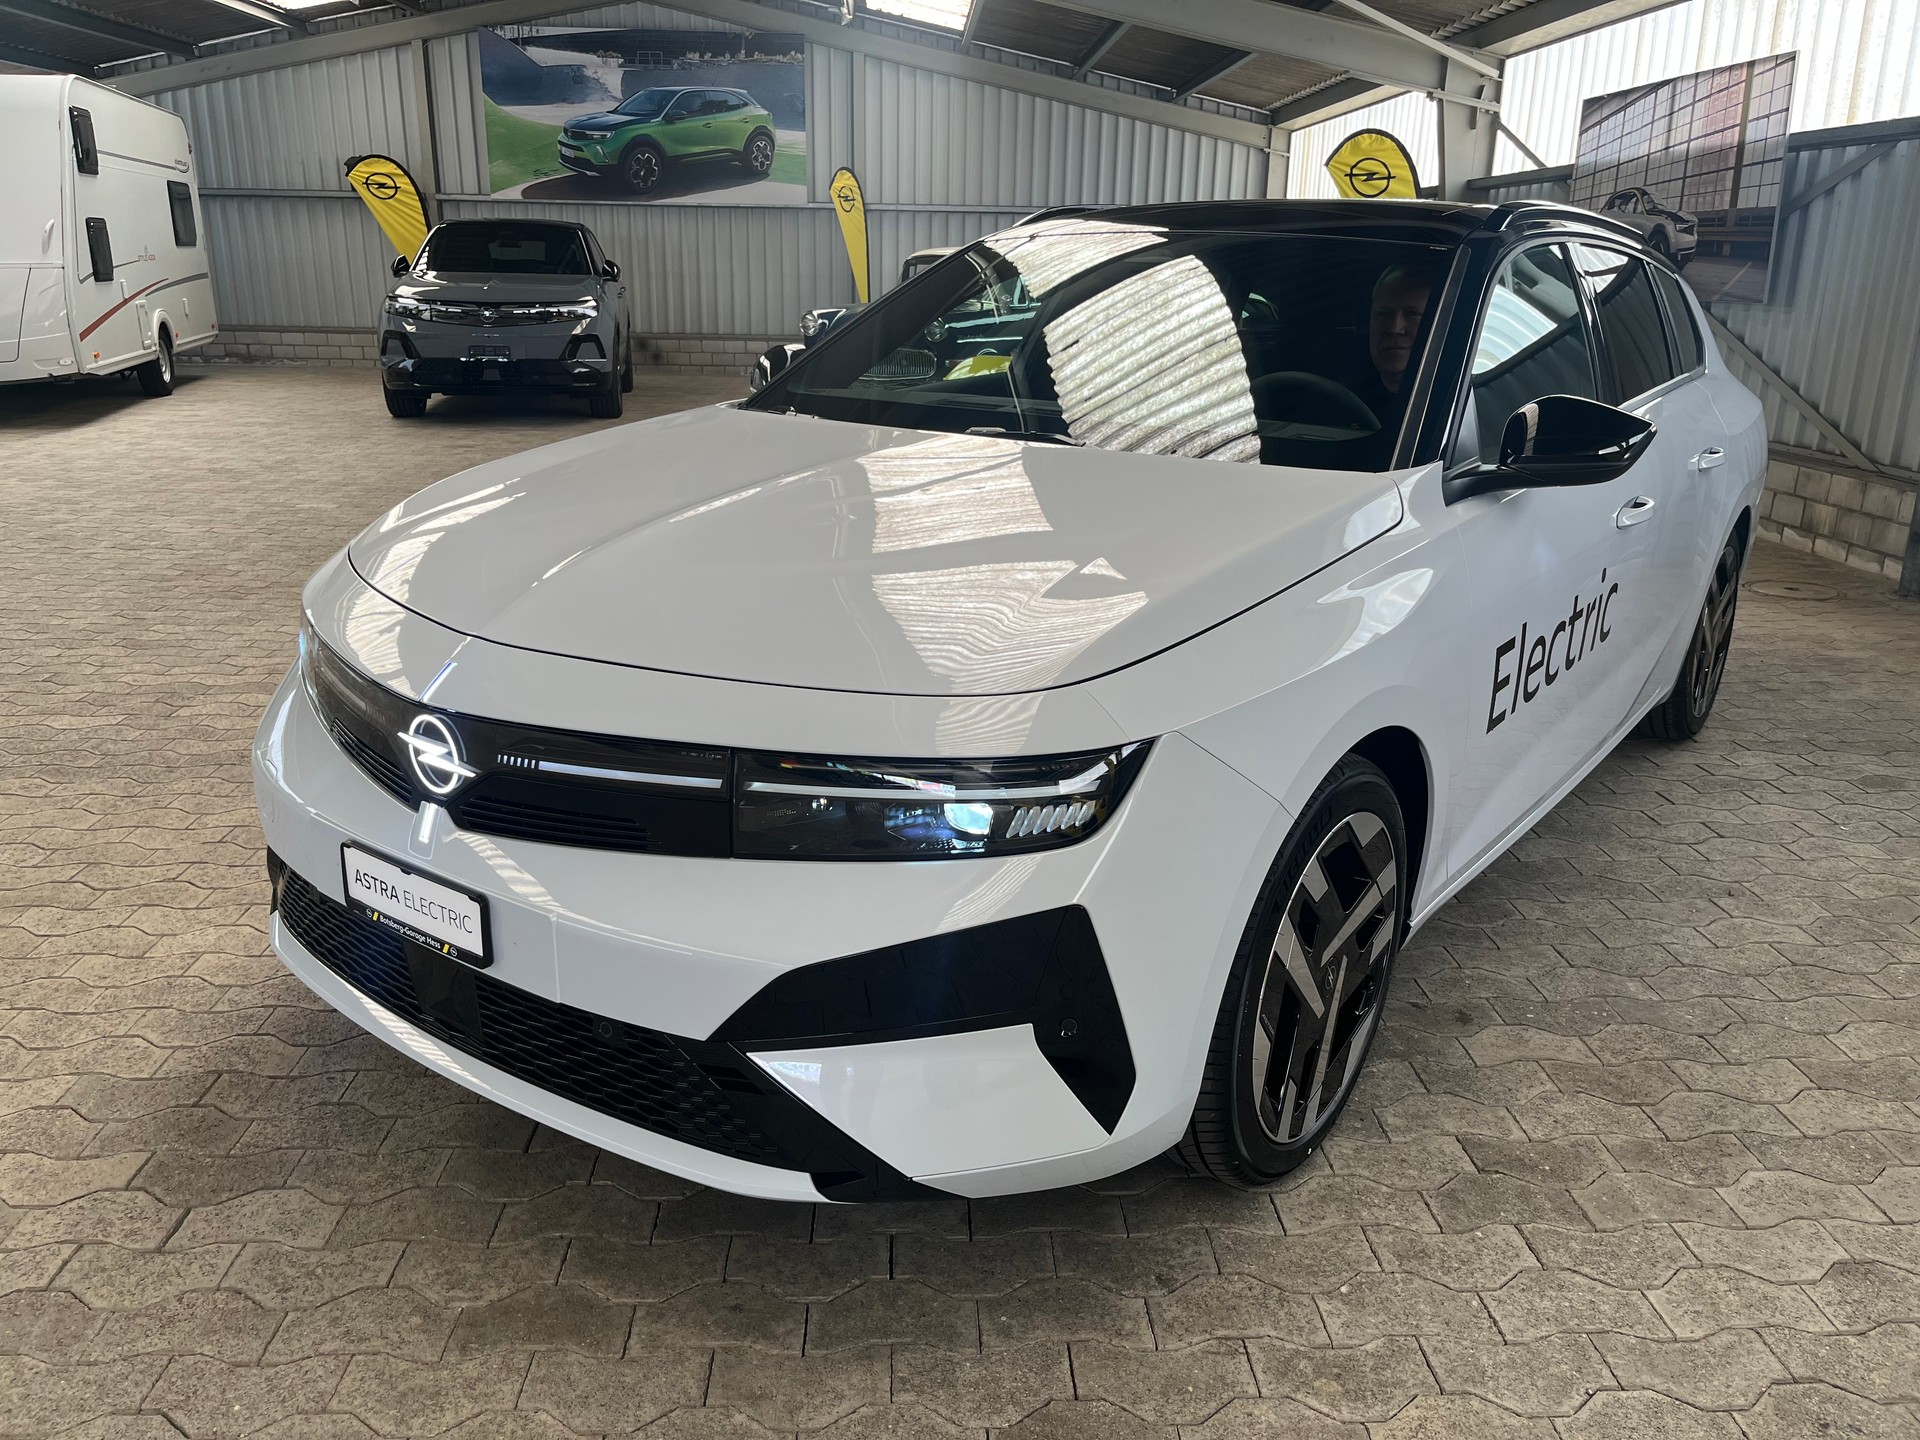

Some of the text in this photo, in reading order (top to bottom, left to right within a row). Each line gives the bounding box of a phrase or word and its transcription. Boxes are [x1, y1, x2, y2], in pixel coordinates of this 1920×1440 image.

[1486, 567, 1619, 735] Electric
[354, 868, 474, 935] ASTRA ELECTRIC
[426, 936, 441, 949] Hess
